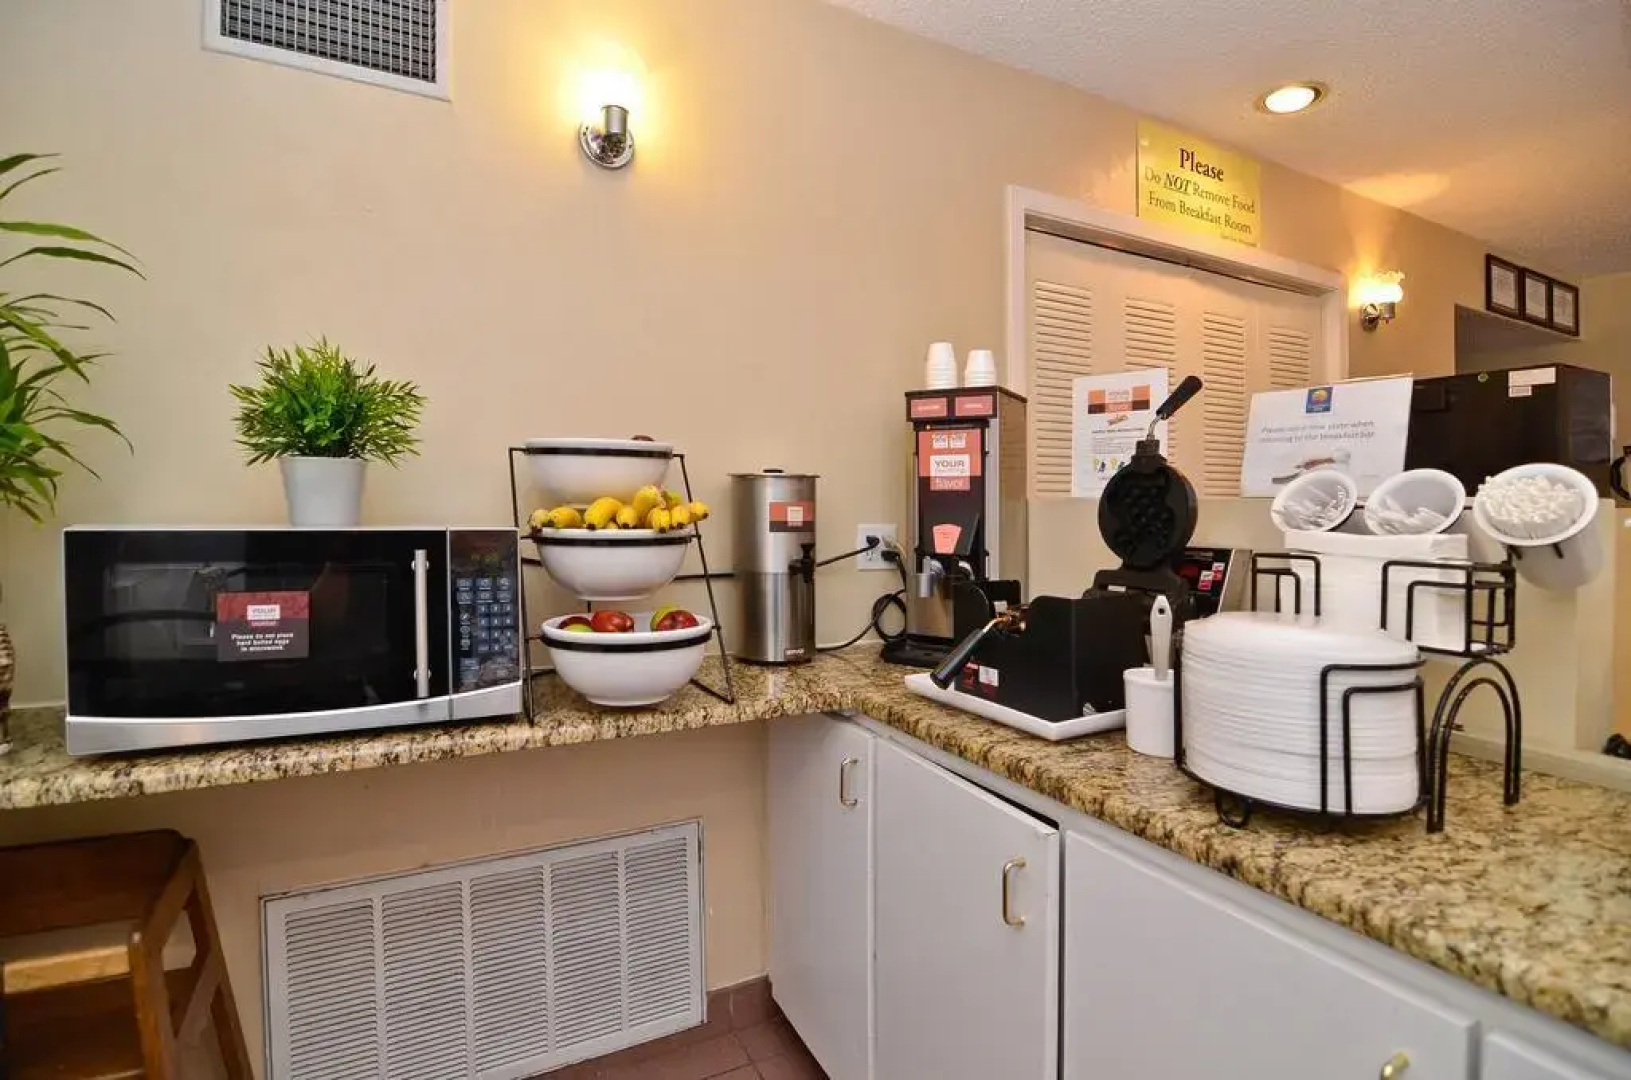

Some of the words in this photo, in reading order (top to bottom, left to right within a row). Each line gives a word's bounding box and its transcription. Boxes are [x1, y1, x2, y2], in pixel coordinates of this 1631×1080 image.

[1180, 148, 1224, 182] Please
[1145, 166, 1162, 184] Do
[1164, 172, 1192, 194] NOT
[1192, 182, 1230, 206] Remove
[1232, 194, 1256, 214] Food
[1148, 190, 1176, 212] From
[1179, 200, 1222, 226] Breakfast
[934, 460, 965, 468] YOUR
